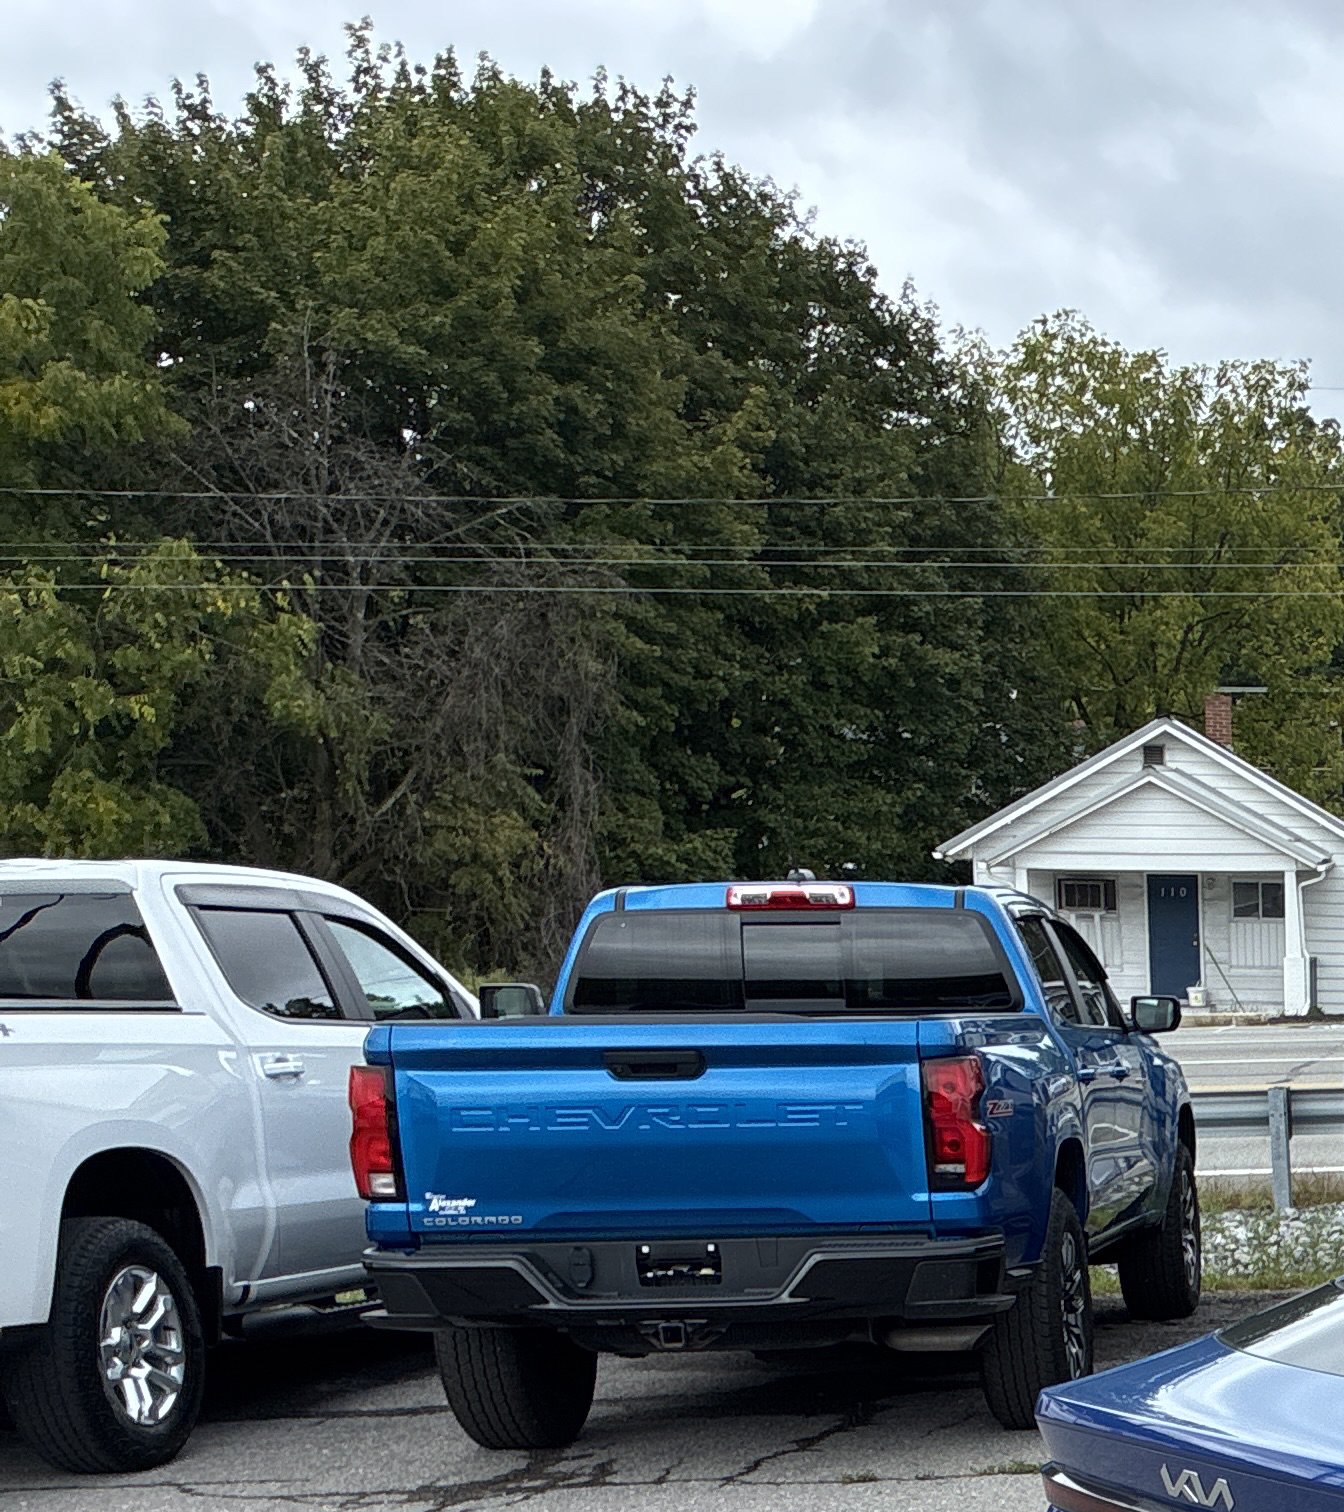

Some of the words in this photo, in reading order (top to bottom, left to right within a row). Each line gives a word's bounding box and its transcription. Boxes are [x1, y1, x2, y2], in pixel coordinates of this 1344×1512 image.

[1160, 887, 1187, 897] 110
[450, 1104, 864, 1132] CHEVROLET
[423, 1215, 523, 1226] COLORADO
[1160, 1463, 1236, 1512] KIA
